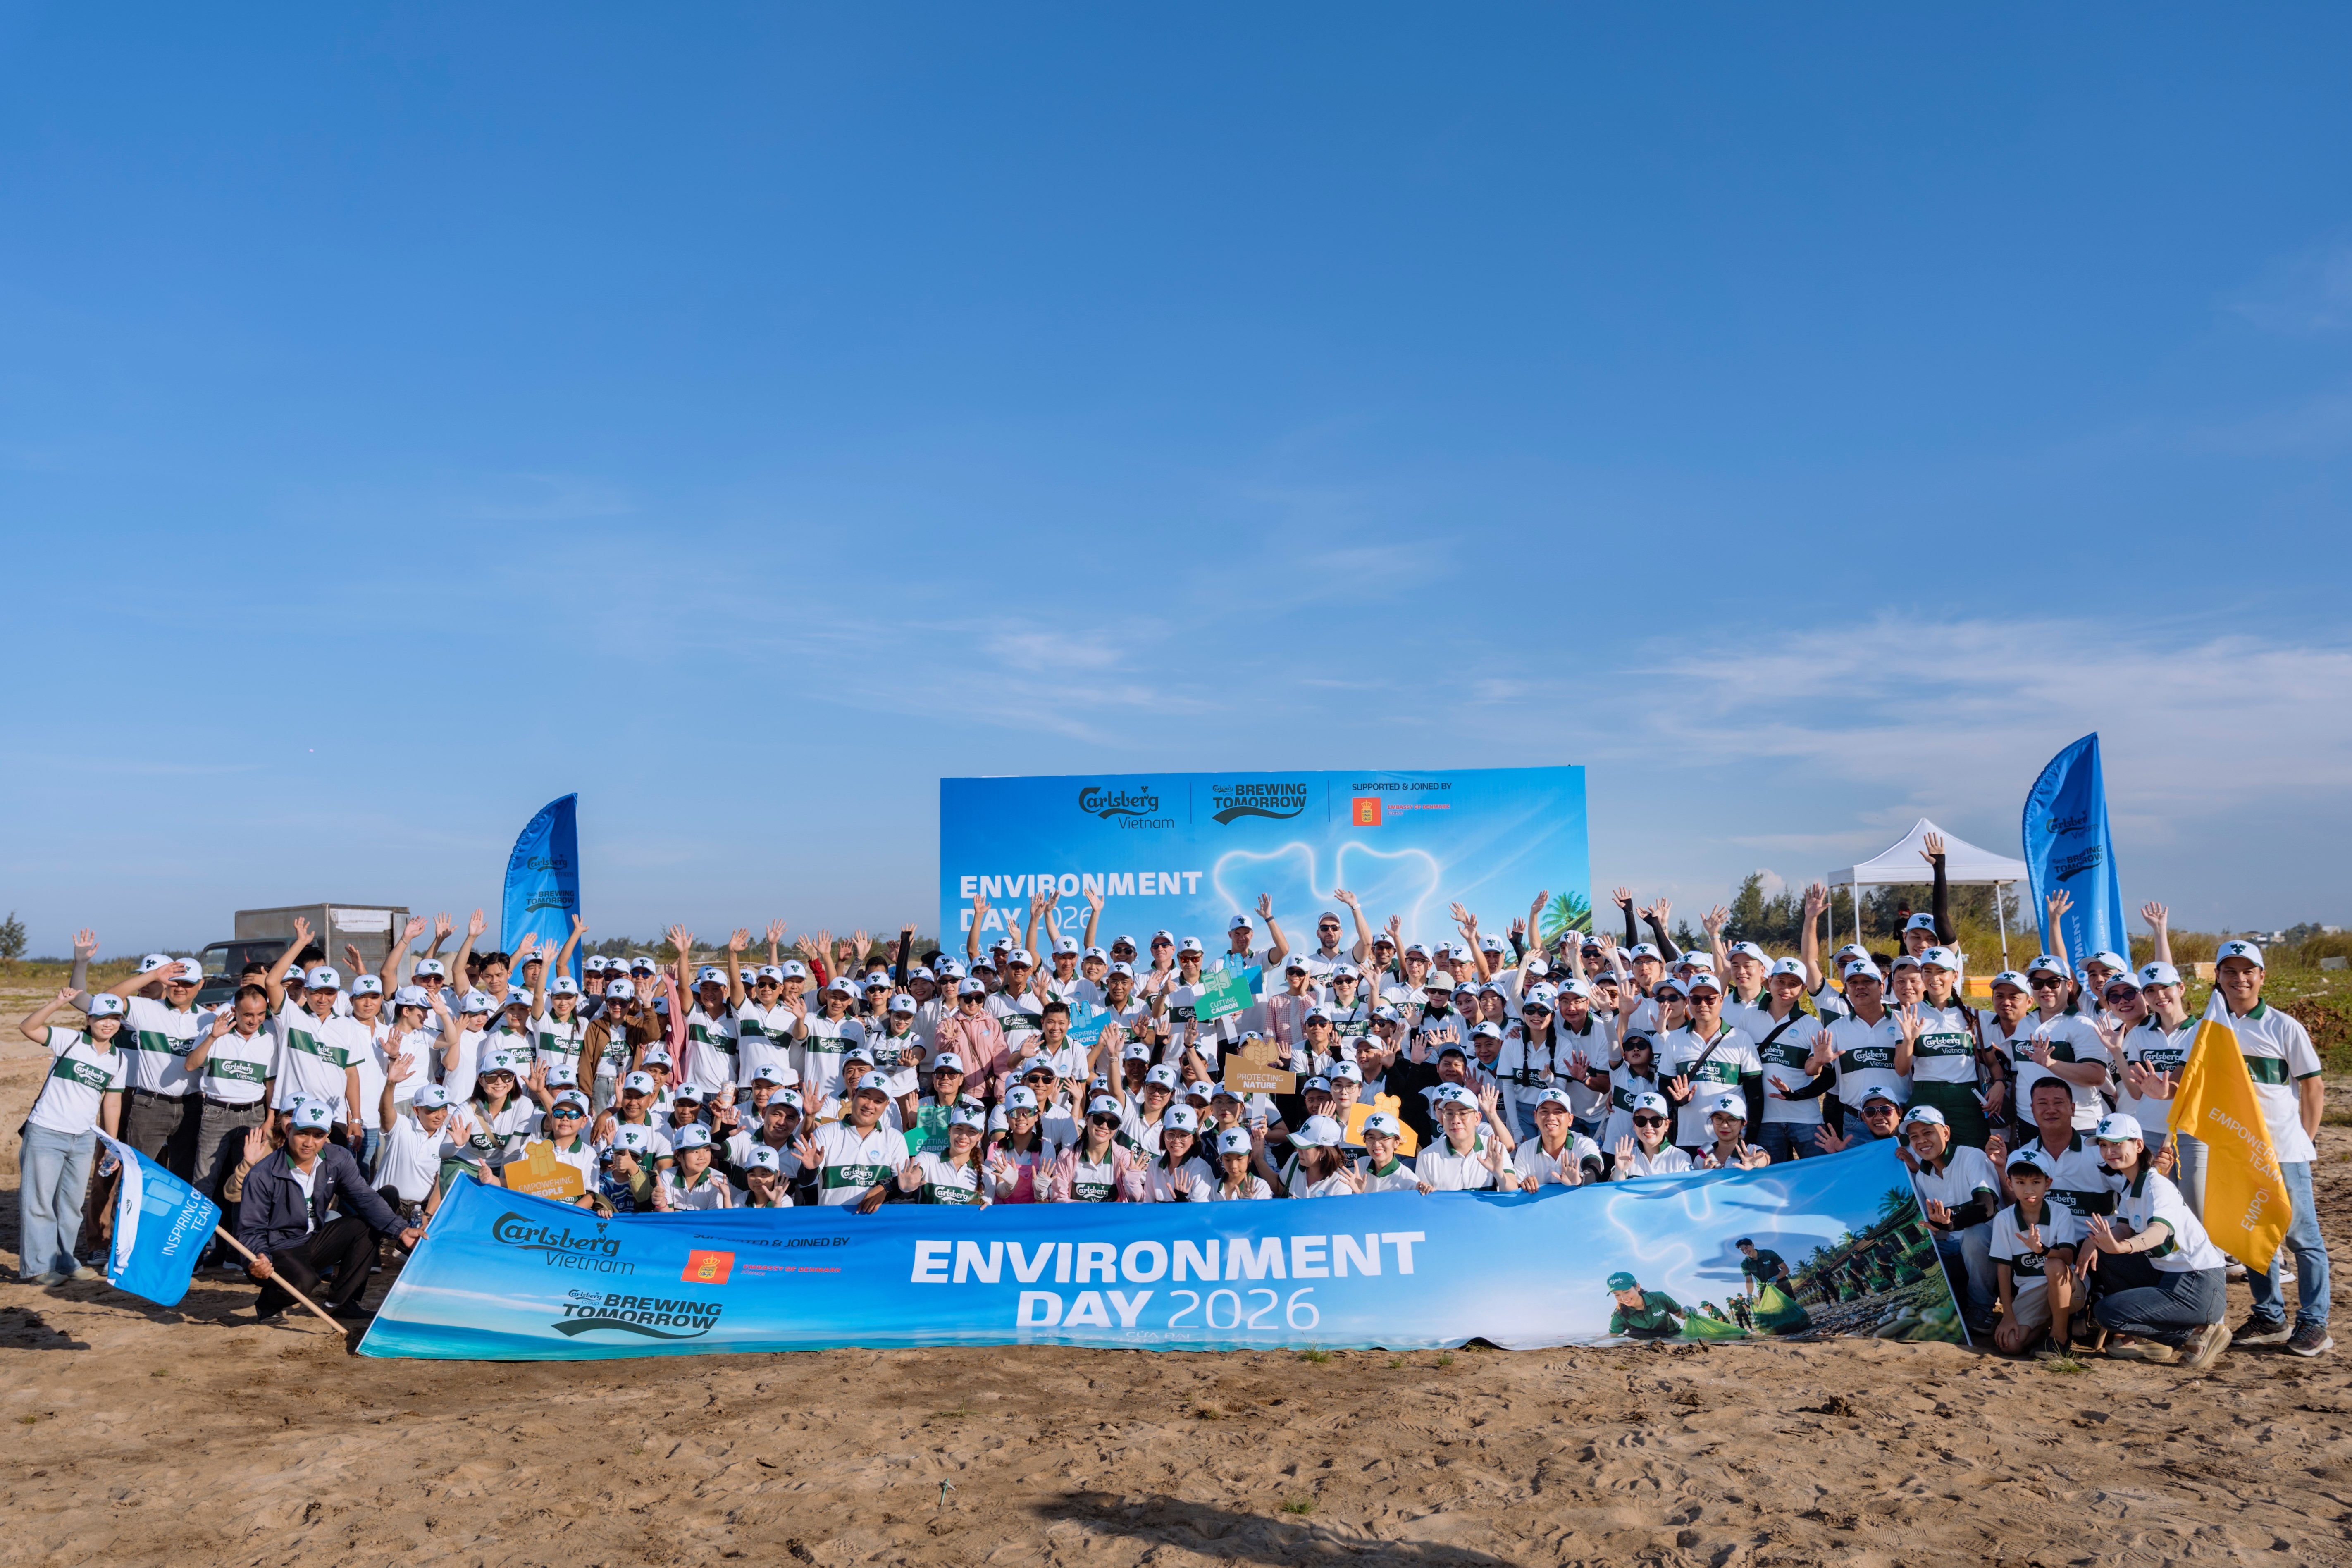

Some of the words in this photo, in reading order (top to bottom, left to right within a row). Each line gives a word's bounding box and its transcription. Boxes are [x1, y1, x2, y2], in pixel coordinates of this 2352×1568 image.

[1236, 783, 1306, 795] BREWING
[1079, 786, 1159, 813] Carlsberg
[1213, 796, 1306, 808] TOMORROW
[1118, 816, 1174, 828] Vietnam
[2046, 814, 2087, 833] Carlsber
[2071, 823, 2099, 840] Vieam
[527, 856, 567, 870] Carlsberg
[960, 871, 1202, 899] ENVIRONMENT
[961, 908, 1022, 931] DAY
[1210, 997, 1236, 1008] CUTTING
[1211, 1002, 1238, 1014] CARBON
[605, 1043, 624, 1053] rlsberg
[820, 1038, 844, 1049] Carlsberg
[1923, 1036, 1961, 1048] Carlsberg
[1767, 1056, 1789, 1066] Vietnam
[1853, 1049, 1887, 1062] Carlsberg
[2143, 1050, 2179, 1063] Carlsberg
[73, 1062, 106, 1083] Carlsberg
[222, 1061, 254, 1074] Carlsberg
[1687, 1062, 1720, 1075] Csberg
[236, 1073, 257, 1081] Vietnam
[1237, 1074, 1283, 1082] PROTECTING
[1703, 1074, 1726, 1082] Vietnam
[2209, 1107, 2278, 1165] EMPOWER
[841, 1166, 873, 1179] Carlsberg
[2249, 1150, 2283, 1185] TEAM
[519, 1176, 574, 1193] EMPOWERING
[1076, 1184, 1108, 1196] Carlsberg
[531, 1186, 564, 1198] PEOPLE
[934, 1186, 968, 1201] Carlsberg
[190, 1202, 213, 1231] TEAM
[162, 1199, 198, 1256] INSPIRING
[492, 1211, 622, 1257] Carlsberg
[784, 1237, 829, 1247] JOINED
[833, 1237, 850, 1246] BY
[547, 1251, 635, 1275] Vietnam
[911, 1231, 1426, 1284] ENVIRONMENT
[2020, 1254, 2048, 1267] Carls
[568, 1289, 603, 1301] Carlsberg
[603, 1293, 723, 1316] BREWING
[1016, 1290, 1156, 1328] DAY
[1168, 1287, 1320, 1330] 2026
[563, 1303, 719, 1329] TOMORROW
